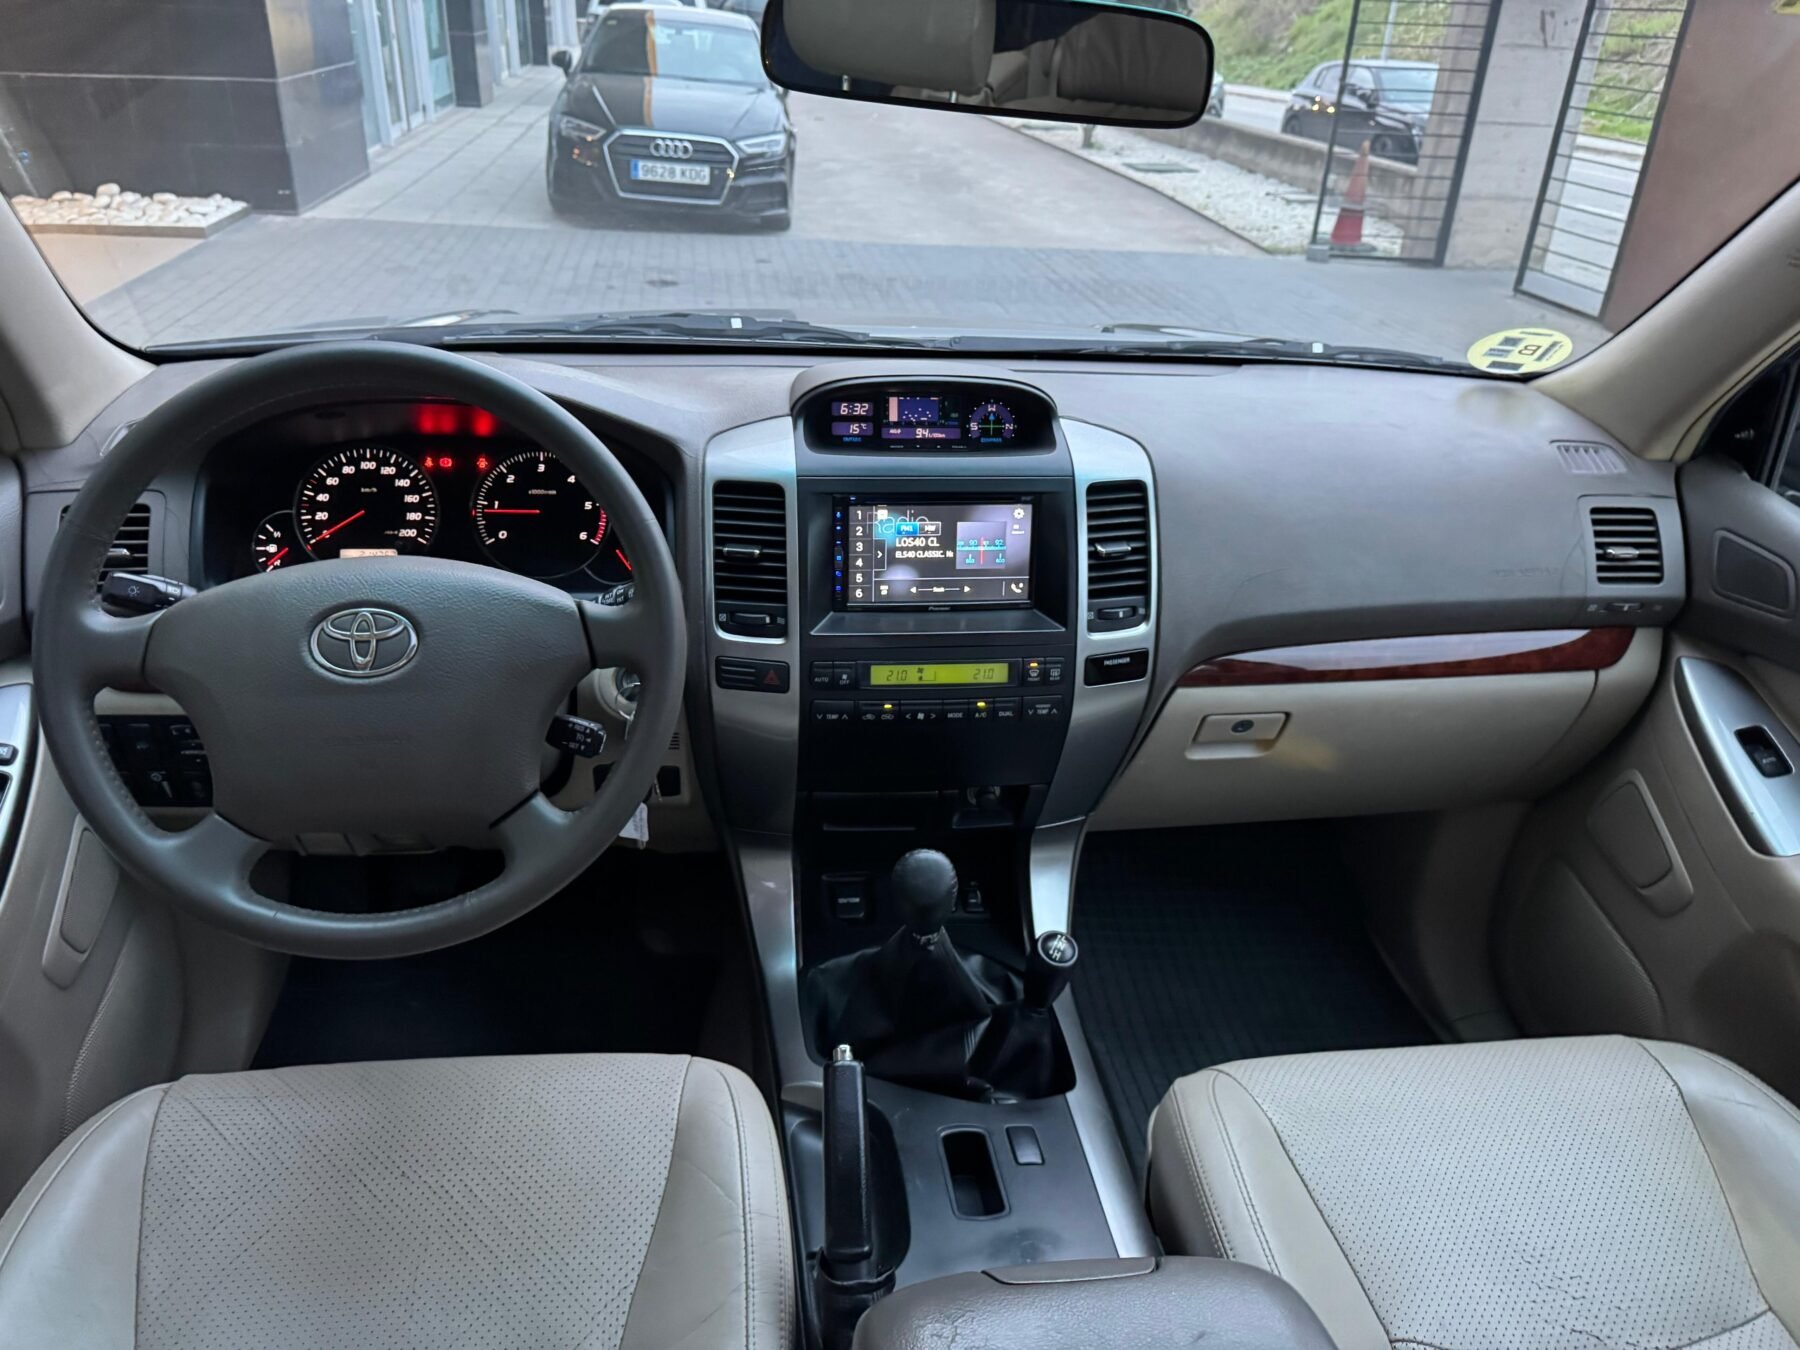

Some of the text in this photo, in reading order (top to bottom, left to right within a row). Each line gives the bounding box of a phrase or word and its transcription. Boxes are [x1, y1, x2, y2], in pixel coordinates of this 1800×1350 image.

[641, 164, 677, 179] 9628
[840, 403, 869, 415] 6:32
[970, 422, 979, 431] S
[341, 466, 356, 474] 80
[360, 461, 377, 470] 100
[537, 464, 546, 472] 3
[380, 466, 397, 475] 120
[326, 477, 340, 485] 60
[394, 479, 411, 487] 140
[506, 475, 516, 483] 2
[567, 475, 576, 483] 4
[315, 493, 330, 502] 40
[403, 494, 420, 503] 160
[493, 501, 499, 510] 1
[584, 501, 593, 510] 5
[314, 512, 329, 520] 20
[406, 512, 422, 521] 180
[856, 510, 862, 520] 1
[398, 529, 418, 537] 200
[498, 530, 508, 539] 0
[855, 526, 863, 536] 2
[579, 532, 588, 540] 6
[855, 541, 864, 552] 3
[895, 537, 940, 547] LOS40 CL
[855, 557, 864, 567] 4
[855, 573, 863, 583] 5
[855, 588, 863, 598] 6
